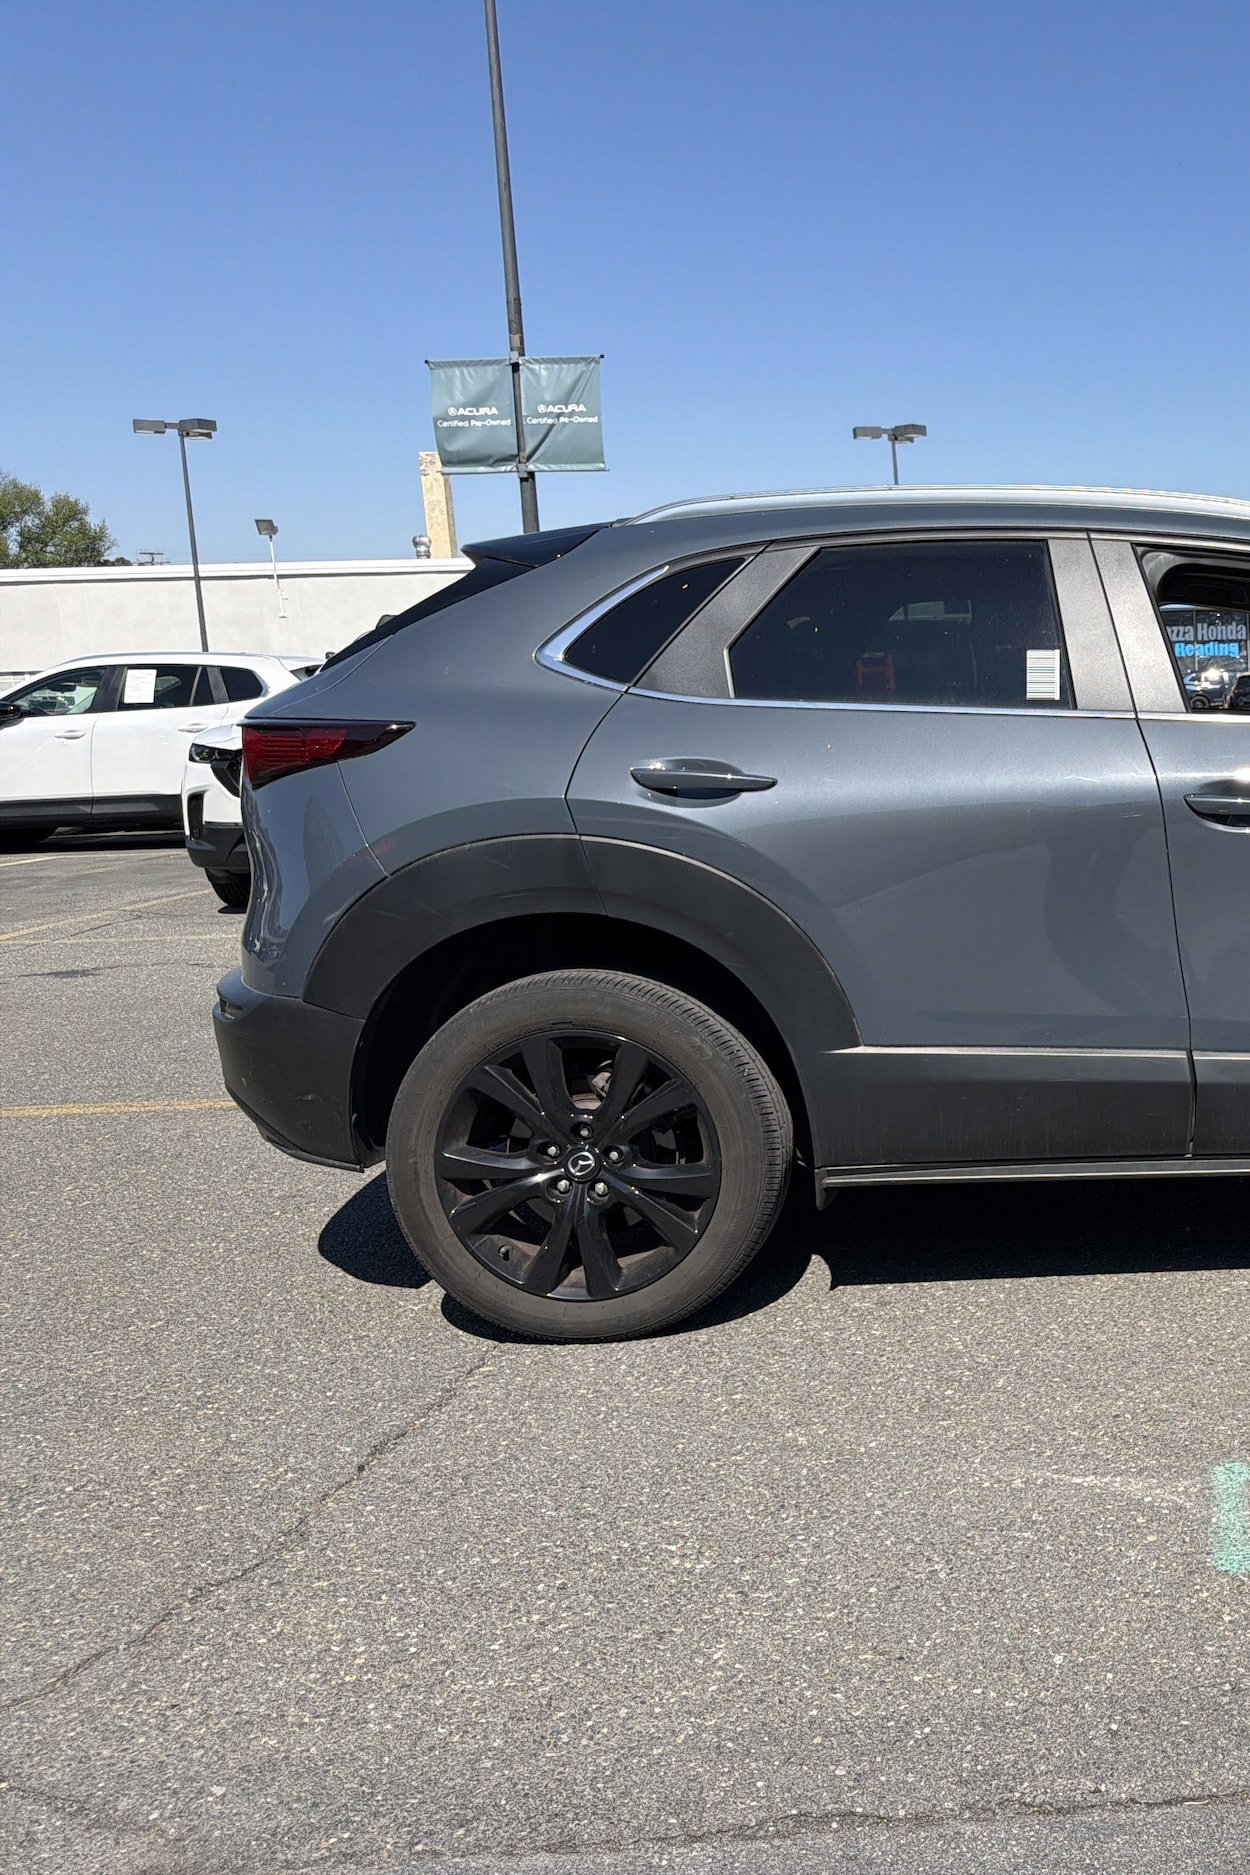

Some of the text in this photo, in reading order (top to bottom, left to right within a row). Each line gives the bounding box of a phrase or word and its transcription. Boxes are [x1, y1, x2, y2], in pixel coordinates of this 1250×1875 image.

[457, 407, 499, 416] ACURA
[547, 404, 586, 413] ACURA
[437, 418, 511, 428] Certified Pre-Owned
[527, 415, 598, 424] Certified Pre-Owned
[1197, 622, 1247, 641] Honda
[1174, 641, 1239, 657] Reading
